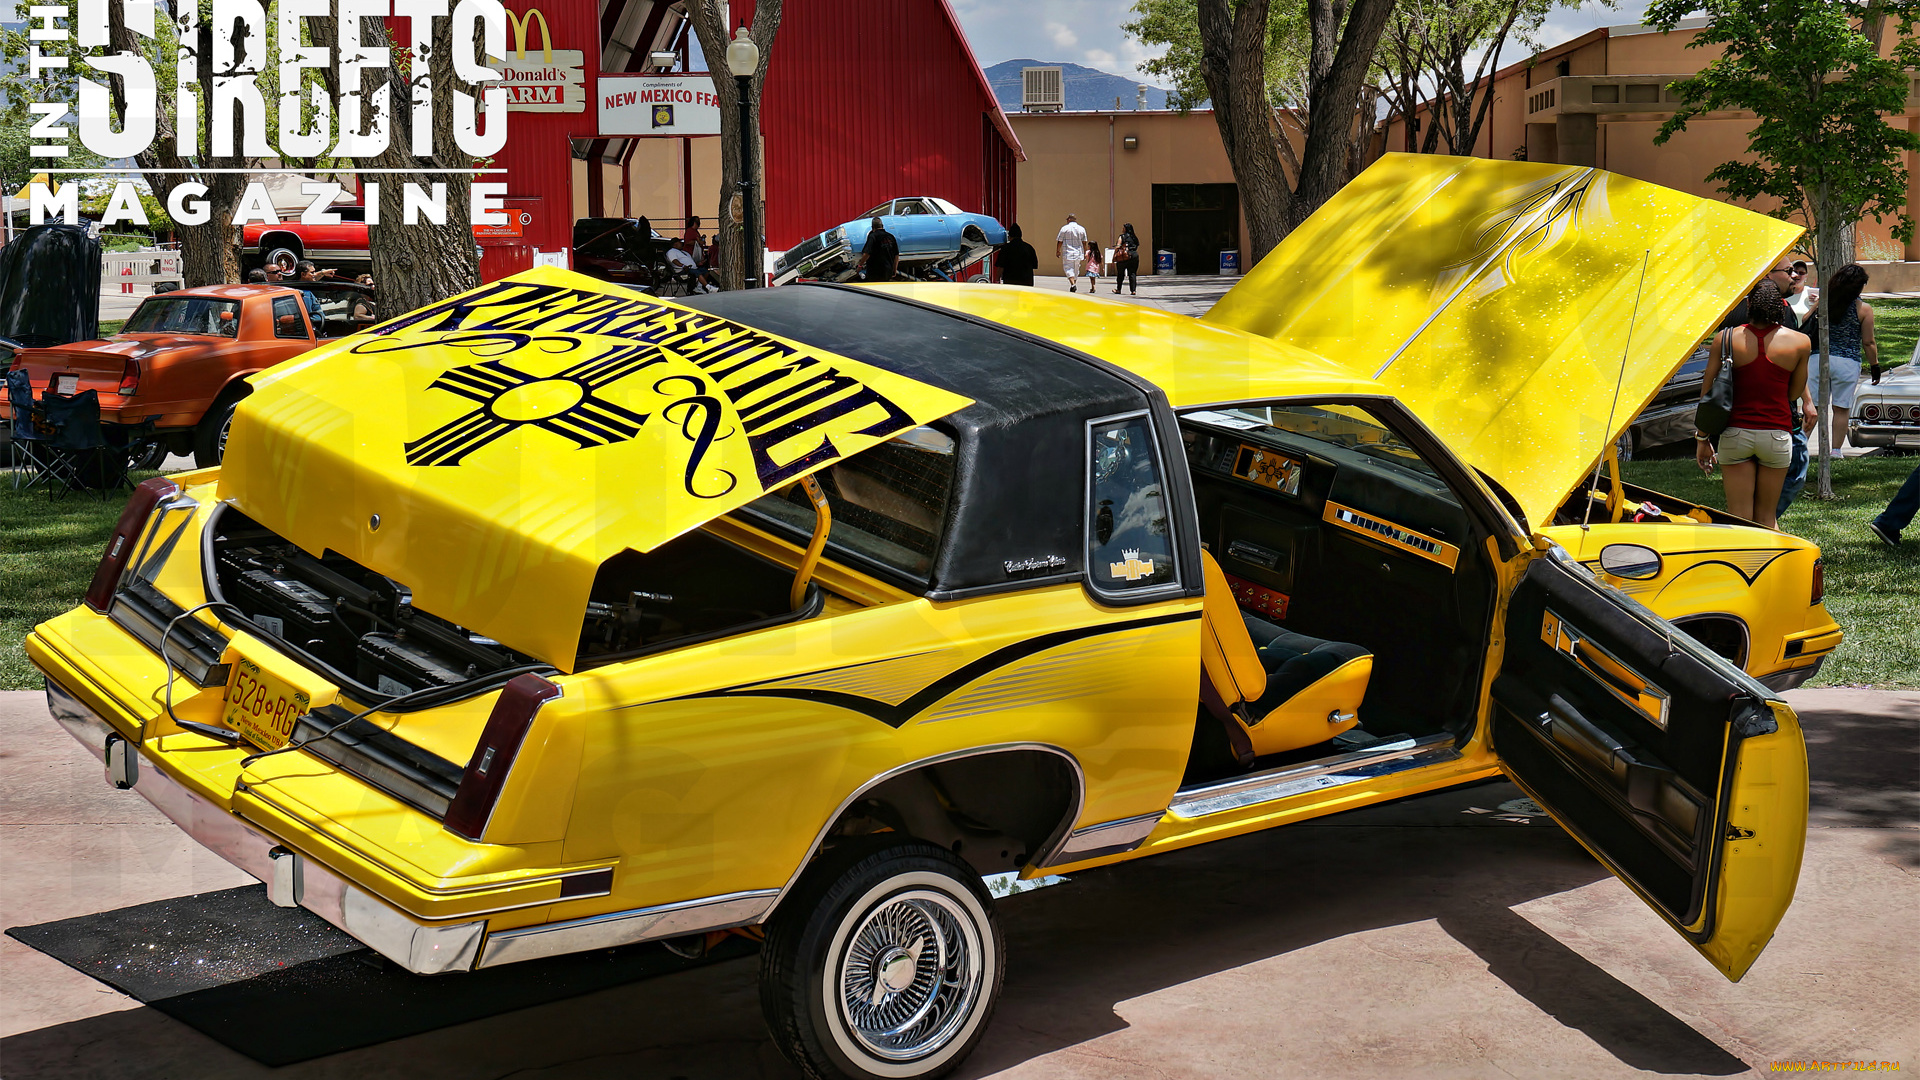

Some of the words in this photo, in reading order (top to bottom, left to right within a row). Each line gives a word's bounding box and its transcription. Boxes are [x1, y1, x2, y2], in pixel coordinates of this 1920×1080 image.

[497, 68, 567, 81] Donald's
[507, 87, 557, 103] ARM
[605, 91, 637, 110] NEW
[640, 89, 692, 103] MEXICO
[696, 92, 720, 108] FFA
[270, 696, 306, 737] RG
[241, 715, 253, 727] New
[252, 722, 272, 740] Mexico
[272, 735, 284, 748] USA
